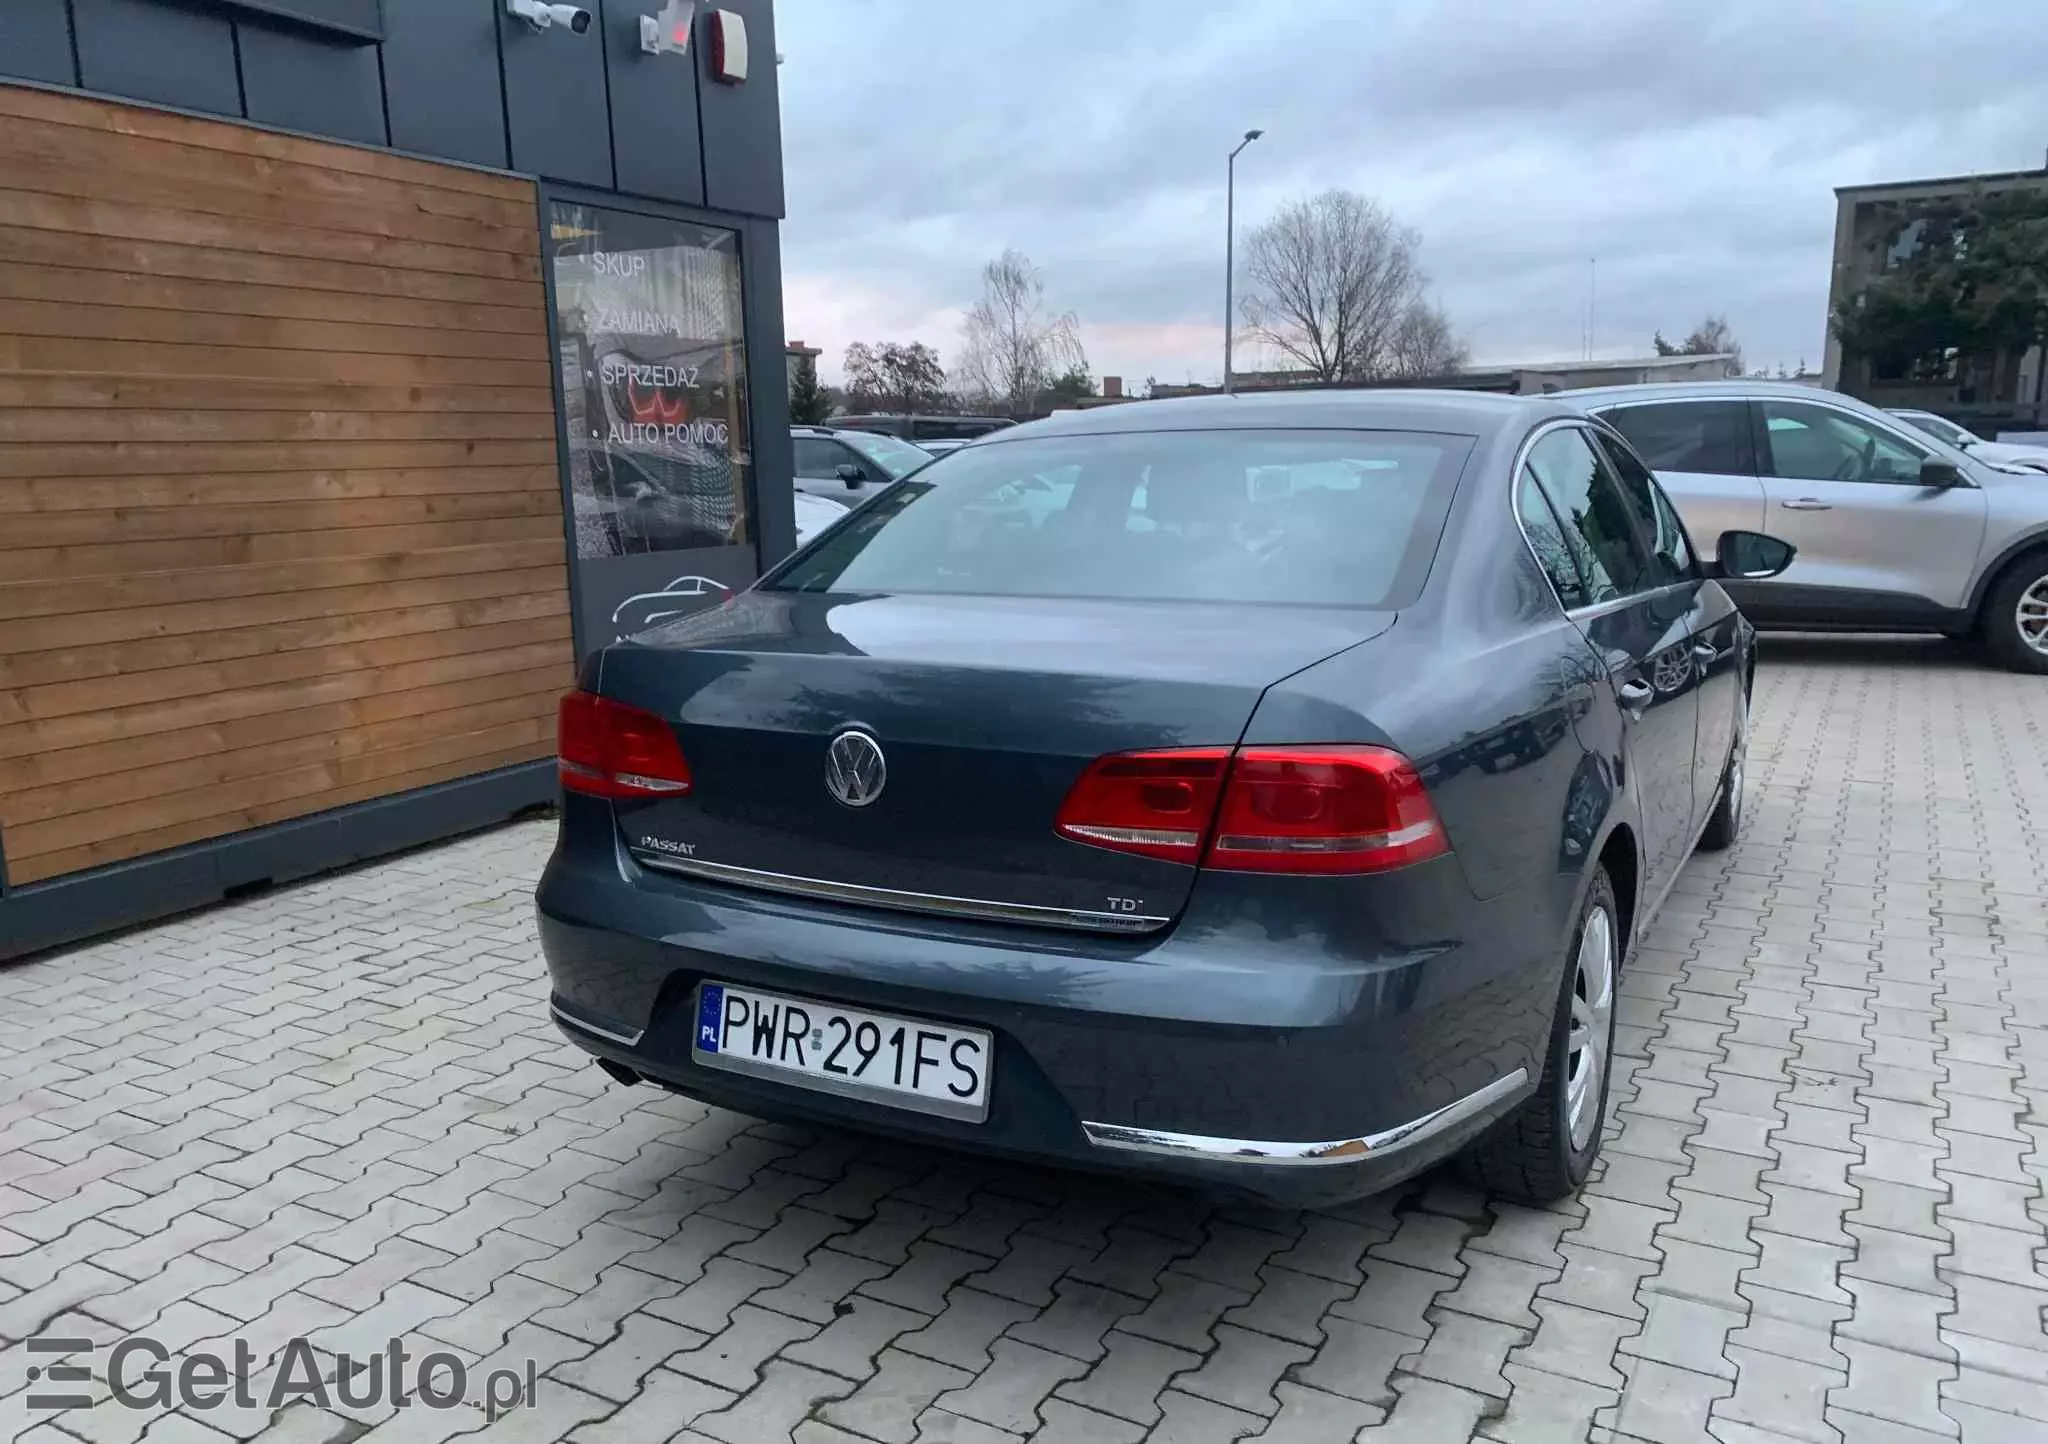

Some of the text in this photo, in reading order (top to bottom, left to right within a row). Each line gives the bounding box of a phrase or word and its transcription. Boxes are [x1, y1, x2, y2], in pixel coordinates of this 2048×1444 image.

[593, 251, 645, 278] SKUP
[597, 308, 681, 336] ZAMIANA
[608, 422, 729, 445] AUTO POMOC
[640, 836, 696, 856] PASSAT
[701, 1025, 717, 1043] PL
[722, 995, 981, 1097] PWR 291FS
